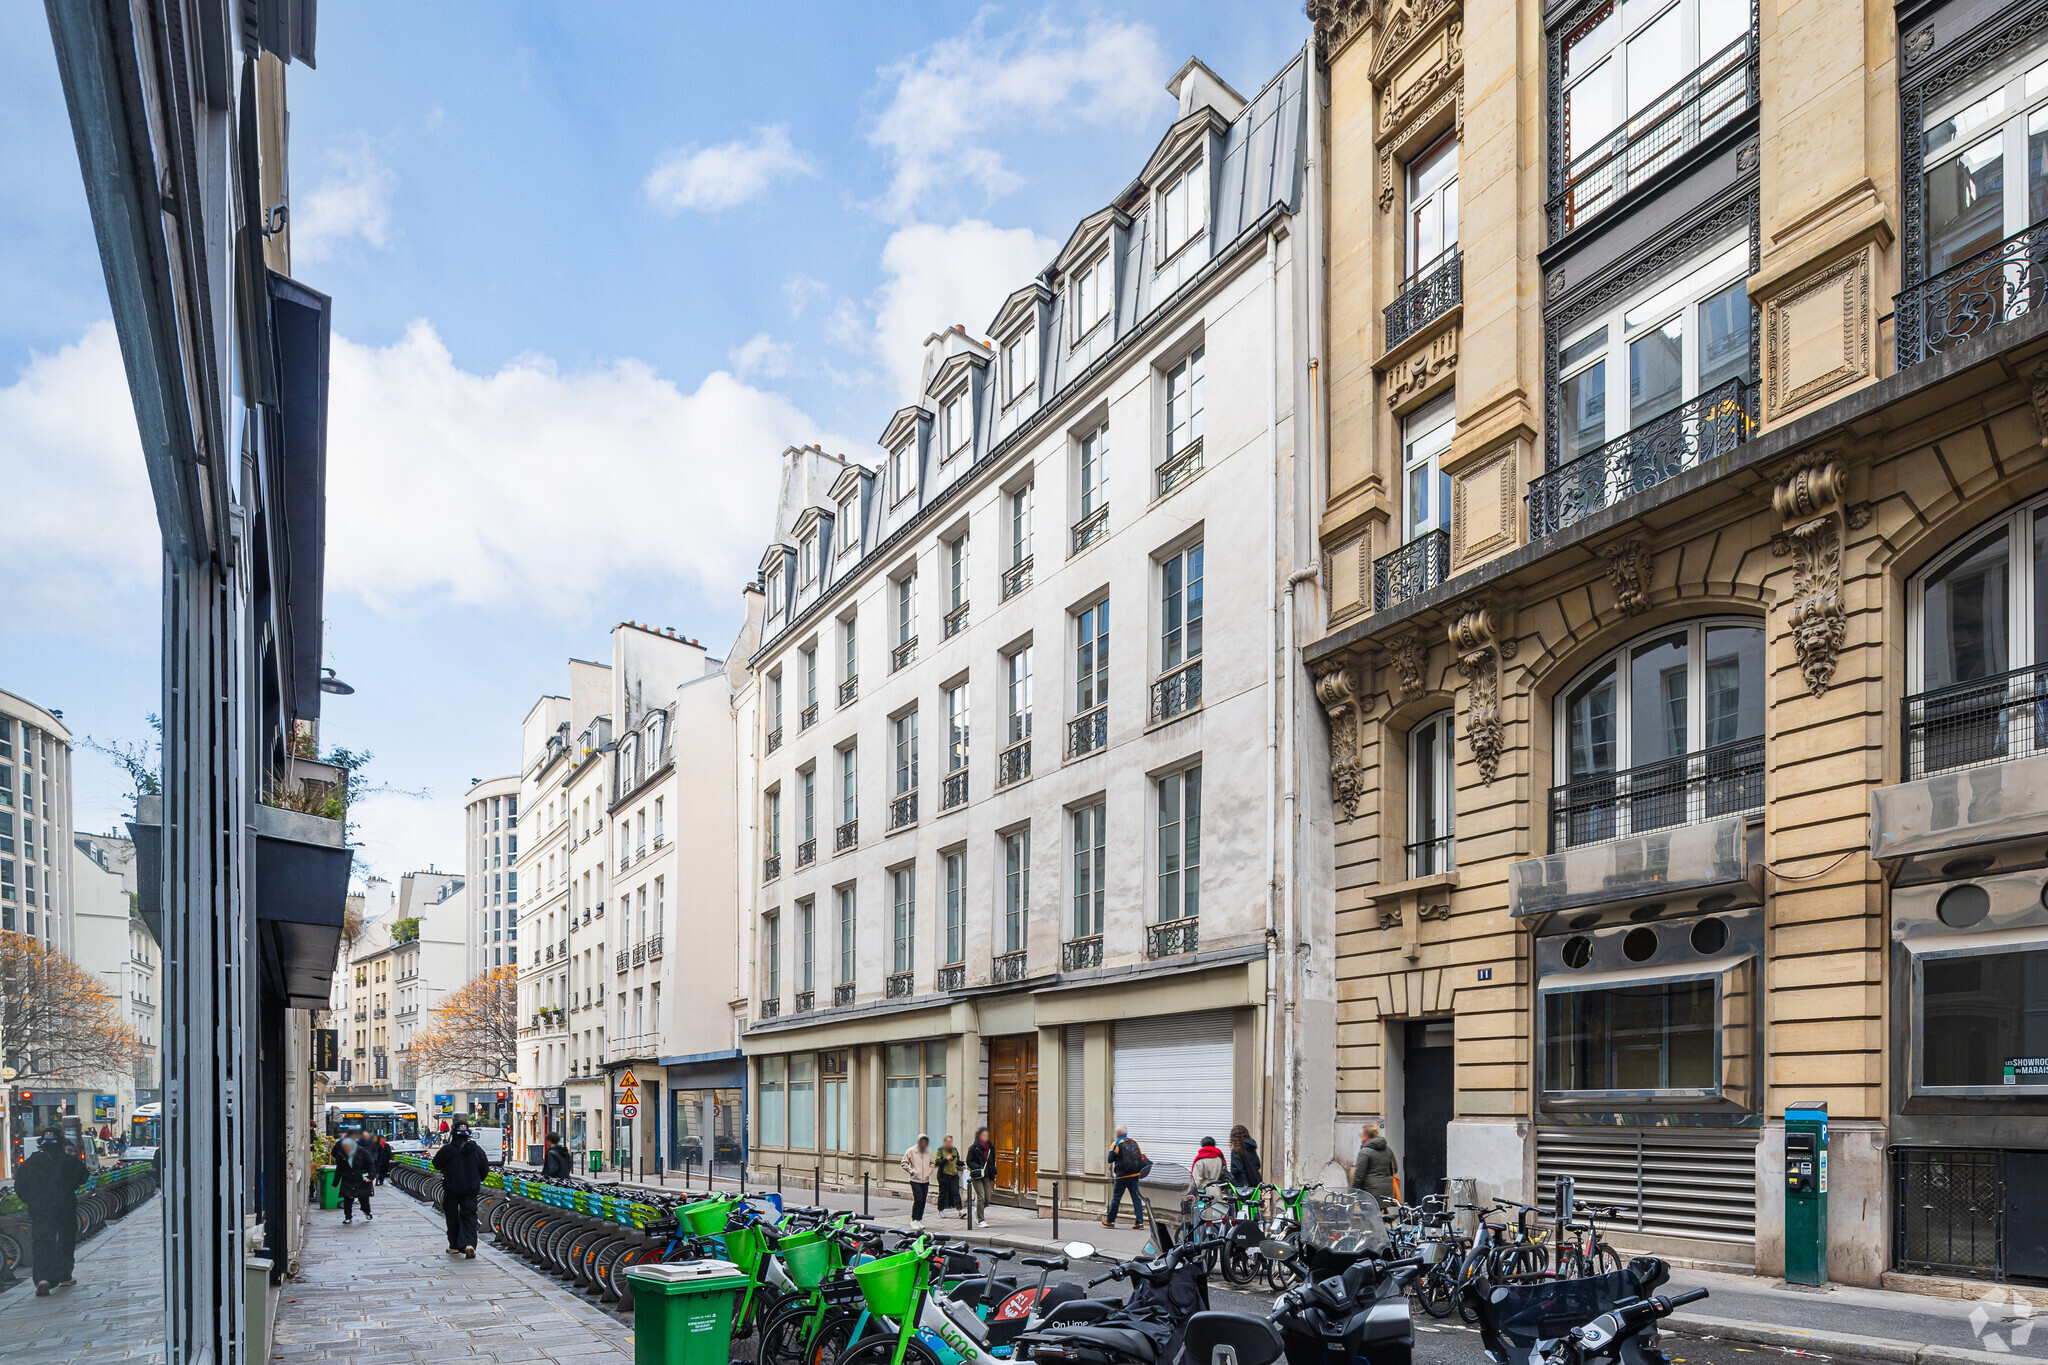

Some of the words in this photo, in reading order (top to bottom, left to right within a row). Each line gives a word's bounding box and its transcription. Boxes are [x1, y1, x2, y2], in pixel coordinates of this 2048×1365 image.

[1480, 970, 1489, 979] 11
[1822, 1124, 1827, 1139] P
[1052, 1321, 1065, 1329] On
[940, 1321, 978, 1361] Lime
